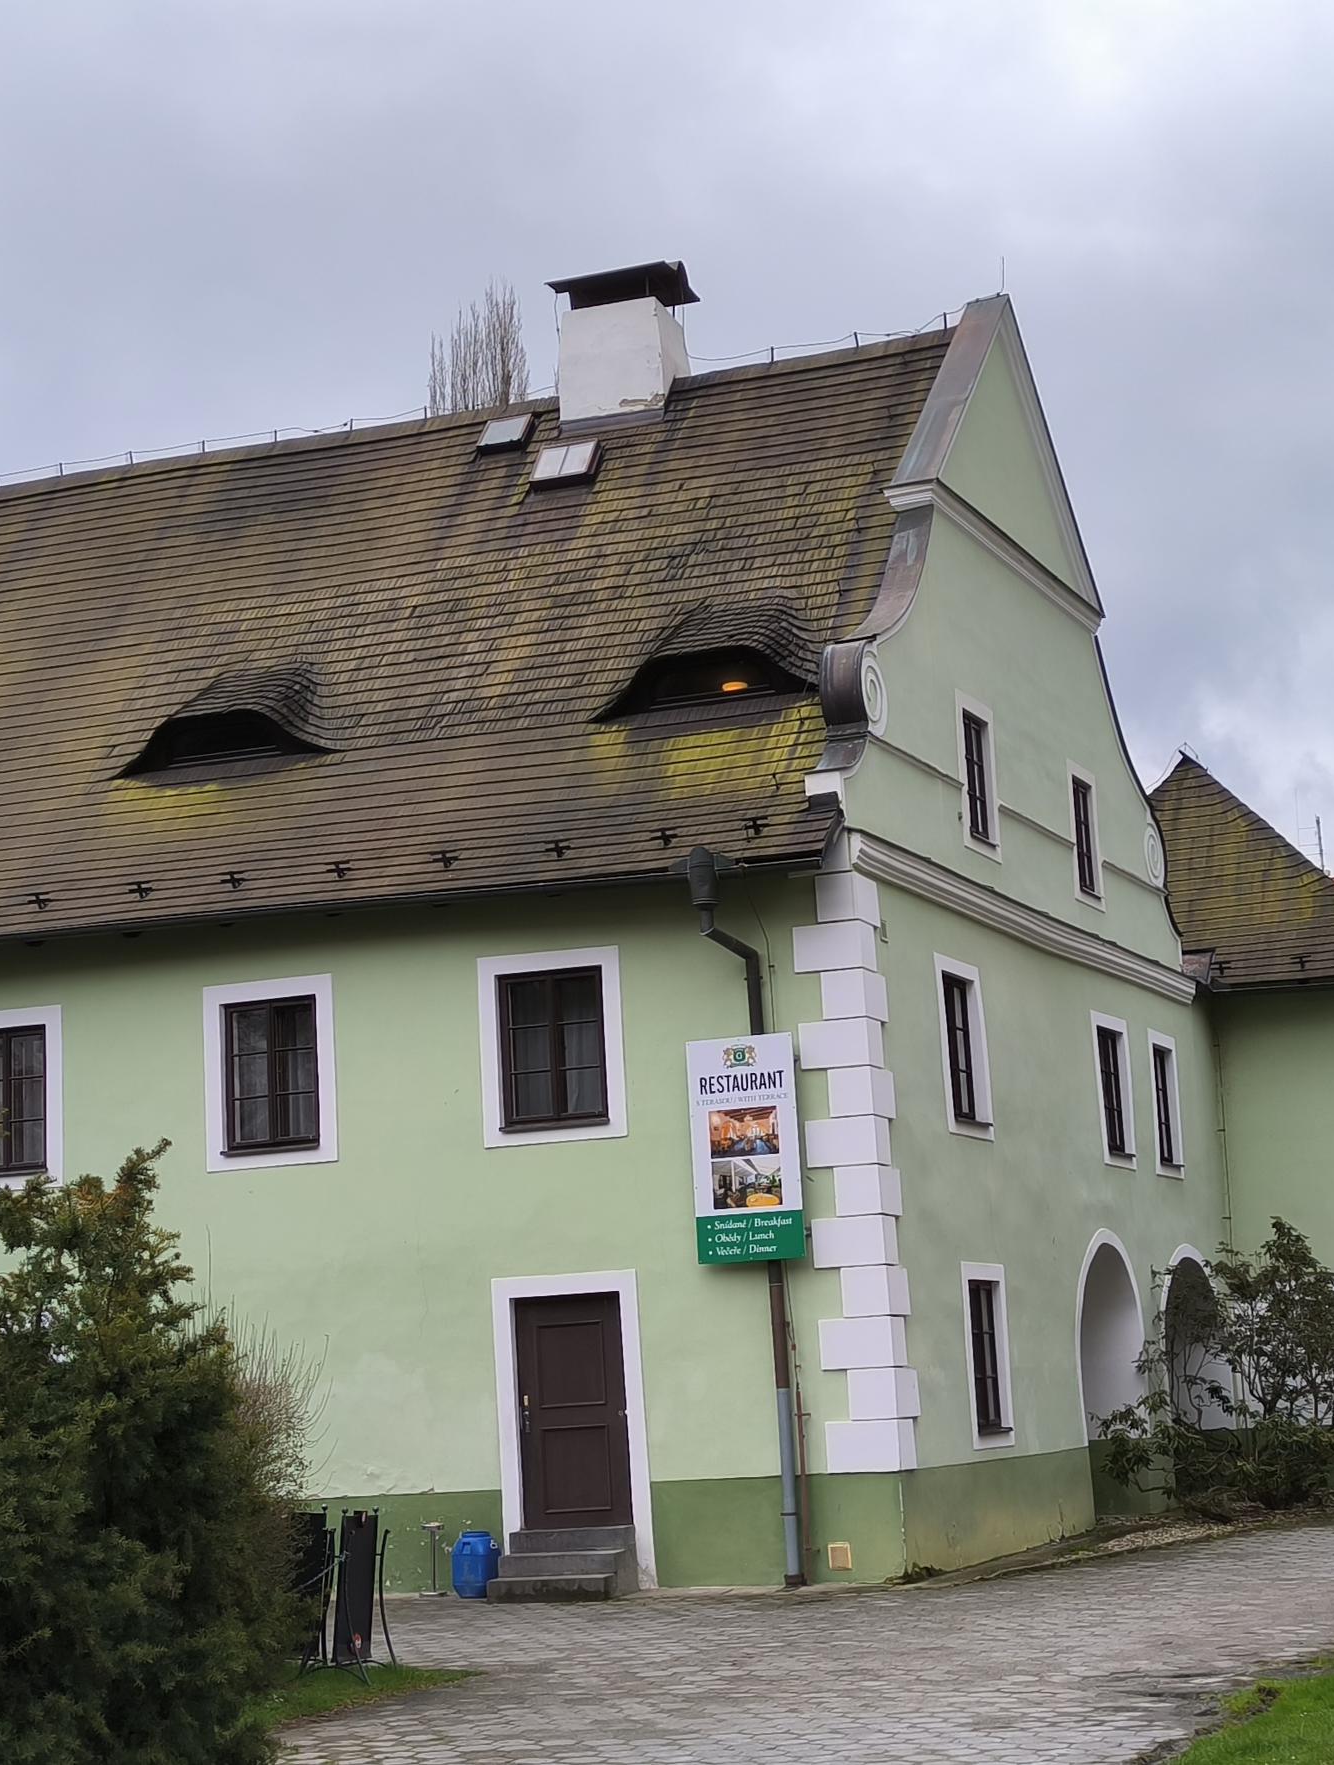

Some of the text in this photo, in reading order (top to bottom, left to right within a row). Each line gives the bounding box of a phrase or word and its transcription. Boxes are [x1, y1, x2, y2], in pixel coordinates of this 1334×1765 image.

[699, 1070, 784, 1095] RESTAURANT
[714, 1219, 747, 1230] Snídaně
[754, 1216, 792, 1227] Breakfast
[714, 1232, 741, 1243] Obědy
[749, 1230, 775, 1241] Lunch
[715, 1246, 741, 1256] Večeře
[749, 1244, 777, 1254] Dinner
